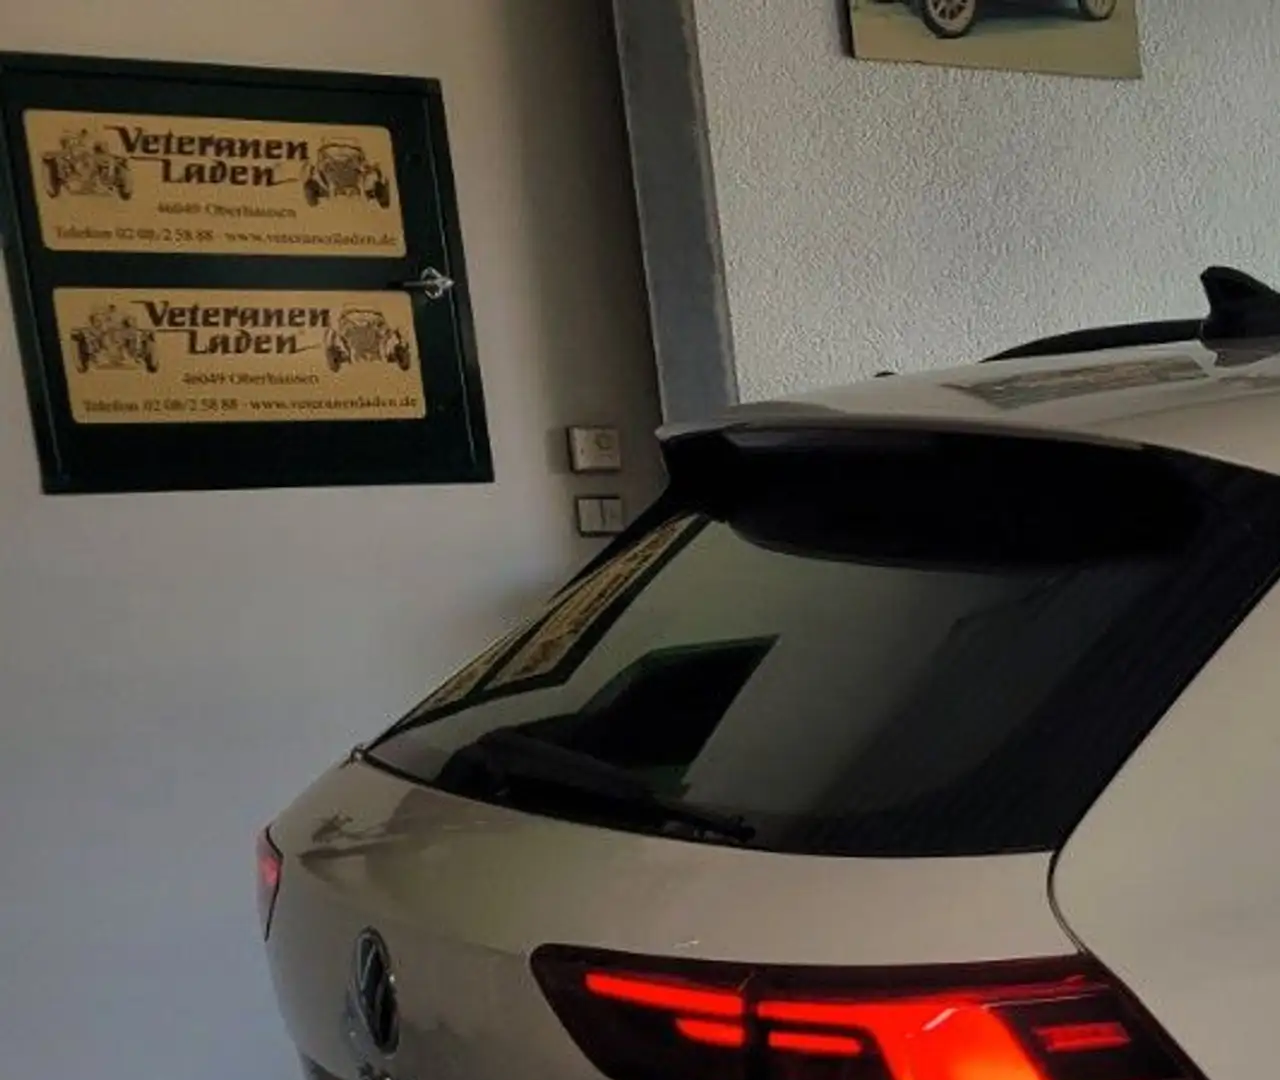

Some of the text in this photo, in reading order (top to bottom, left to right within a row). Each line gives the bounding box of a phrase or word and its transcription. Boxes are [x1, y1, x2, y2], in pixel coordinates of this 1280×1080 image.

[104, 125, 309, 161] Veteranen
[131, 155, 299, 188] Laden
[131, 301, 330, 328] Veteranen
[149, 328, 316, 355] Laden
